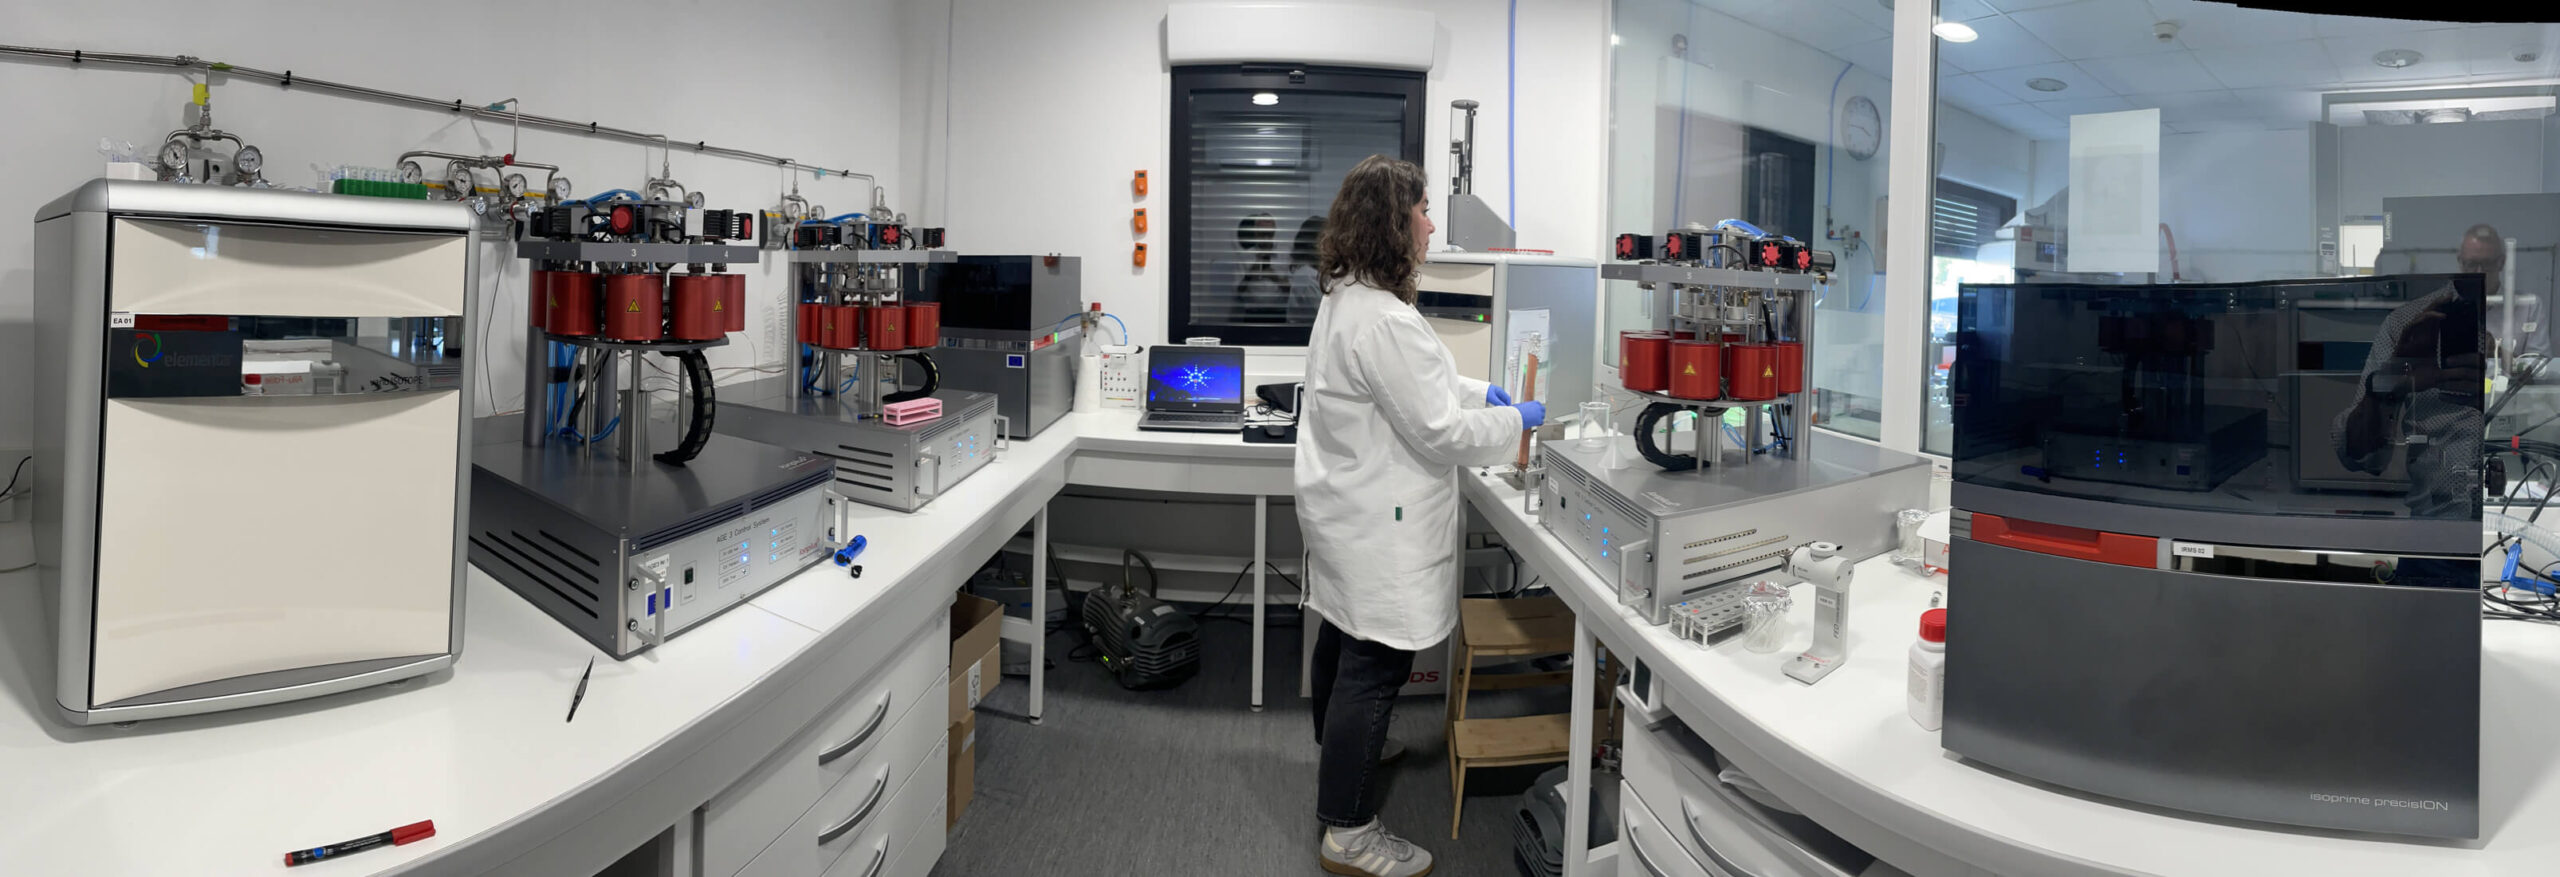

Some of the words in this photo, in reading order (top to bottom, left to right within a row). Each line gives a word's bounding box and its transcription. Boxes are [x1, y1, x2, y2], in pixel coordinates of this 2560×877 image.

[631, 249, 637, 257] 3
[734, 525, 752, 537] Control
[1409, 671, 1439, 683] DS
[2310, 793, 2370, 805] isoprime
[2374, 798, 2449, 811] precisION
